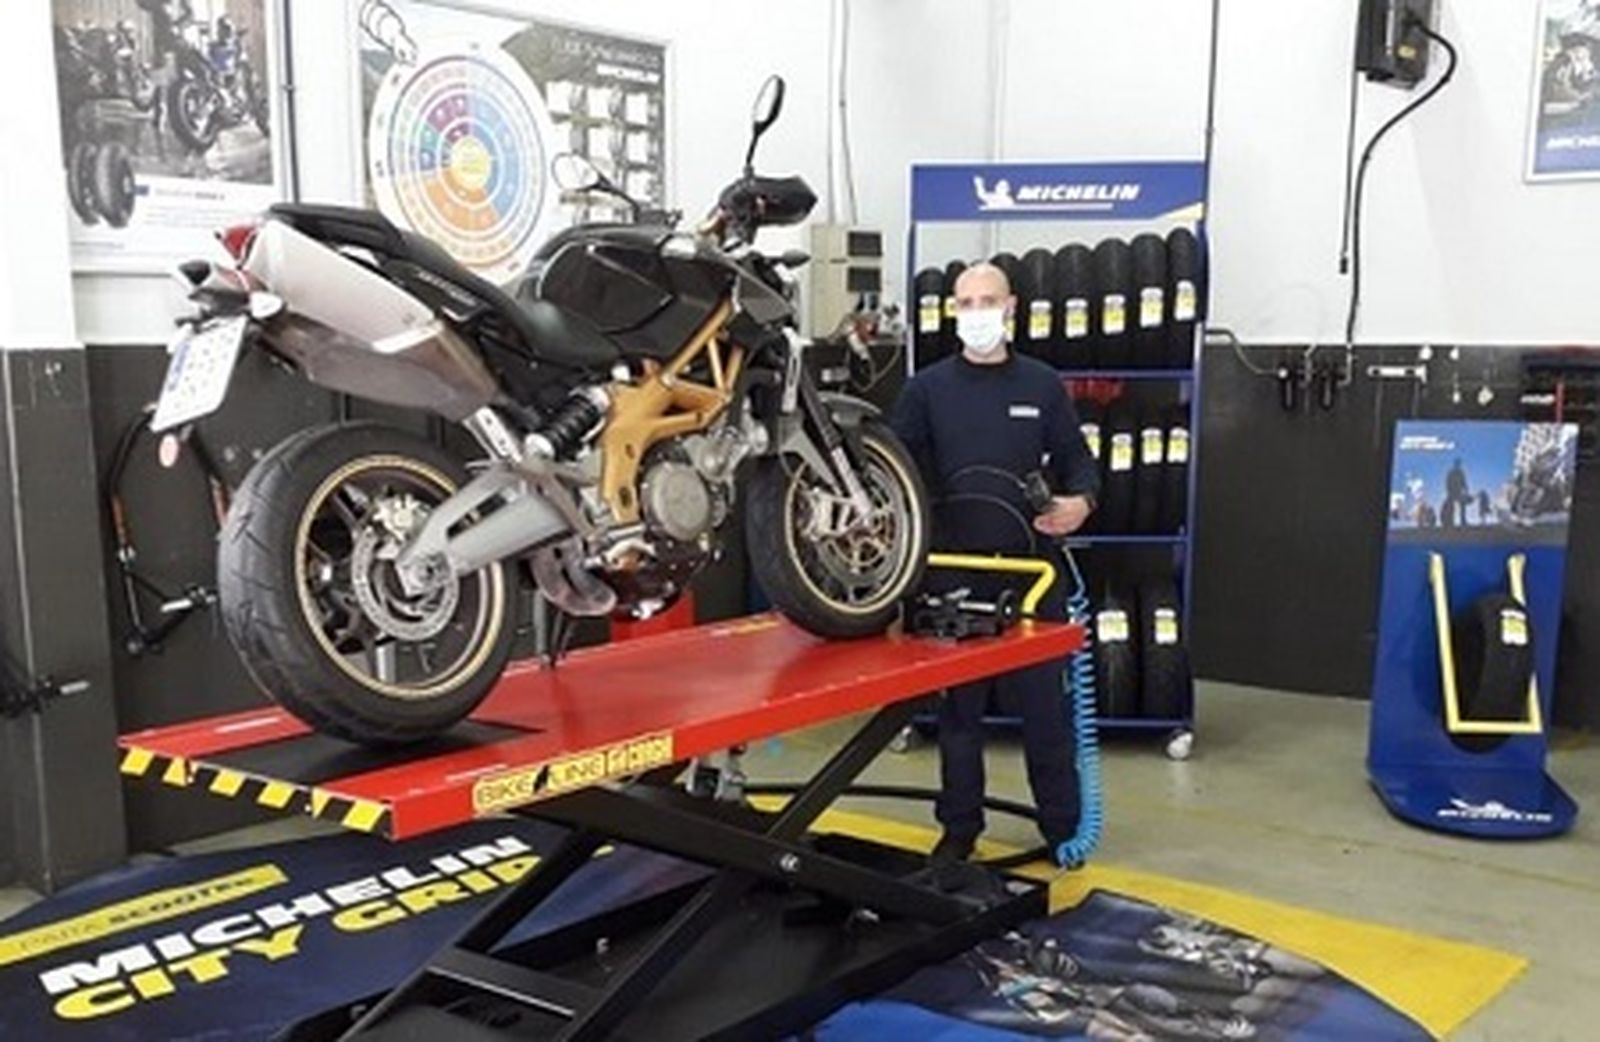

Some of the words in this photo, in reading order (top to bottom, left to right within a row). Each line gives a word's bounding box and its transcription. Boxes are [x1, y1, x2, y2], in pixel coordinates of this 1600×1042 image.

[1016, 183, 1141, 201] MICHELIN
[38, 836, 532, 995] MICHELIN
[53, 922, 304, 1019] CITY
[332, 855, 542, 931] GRID
